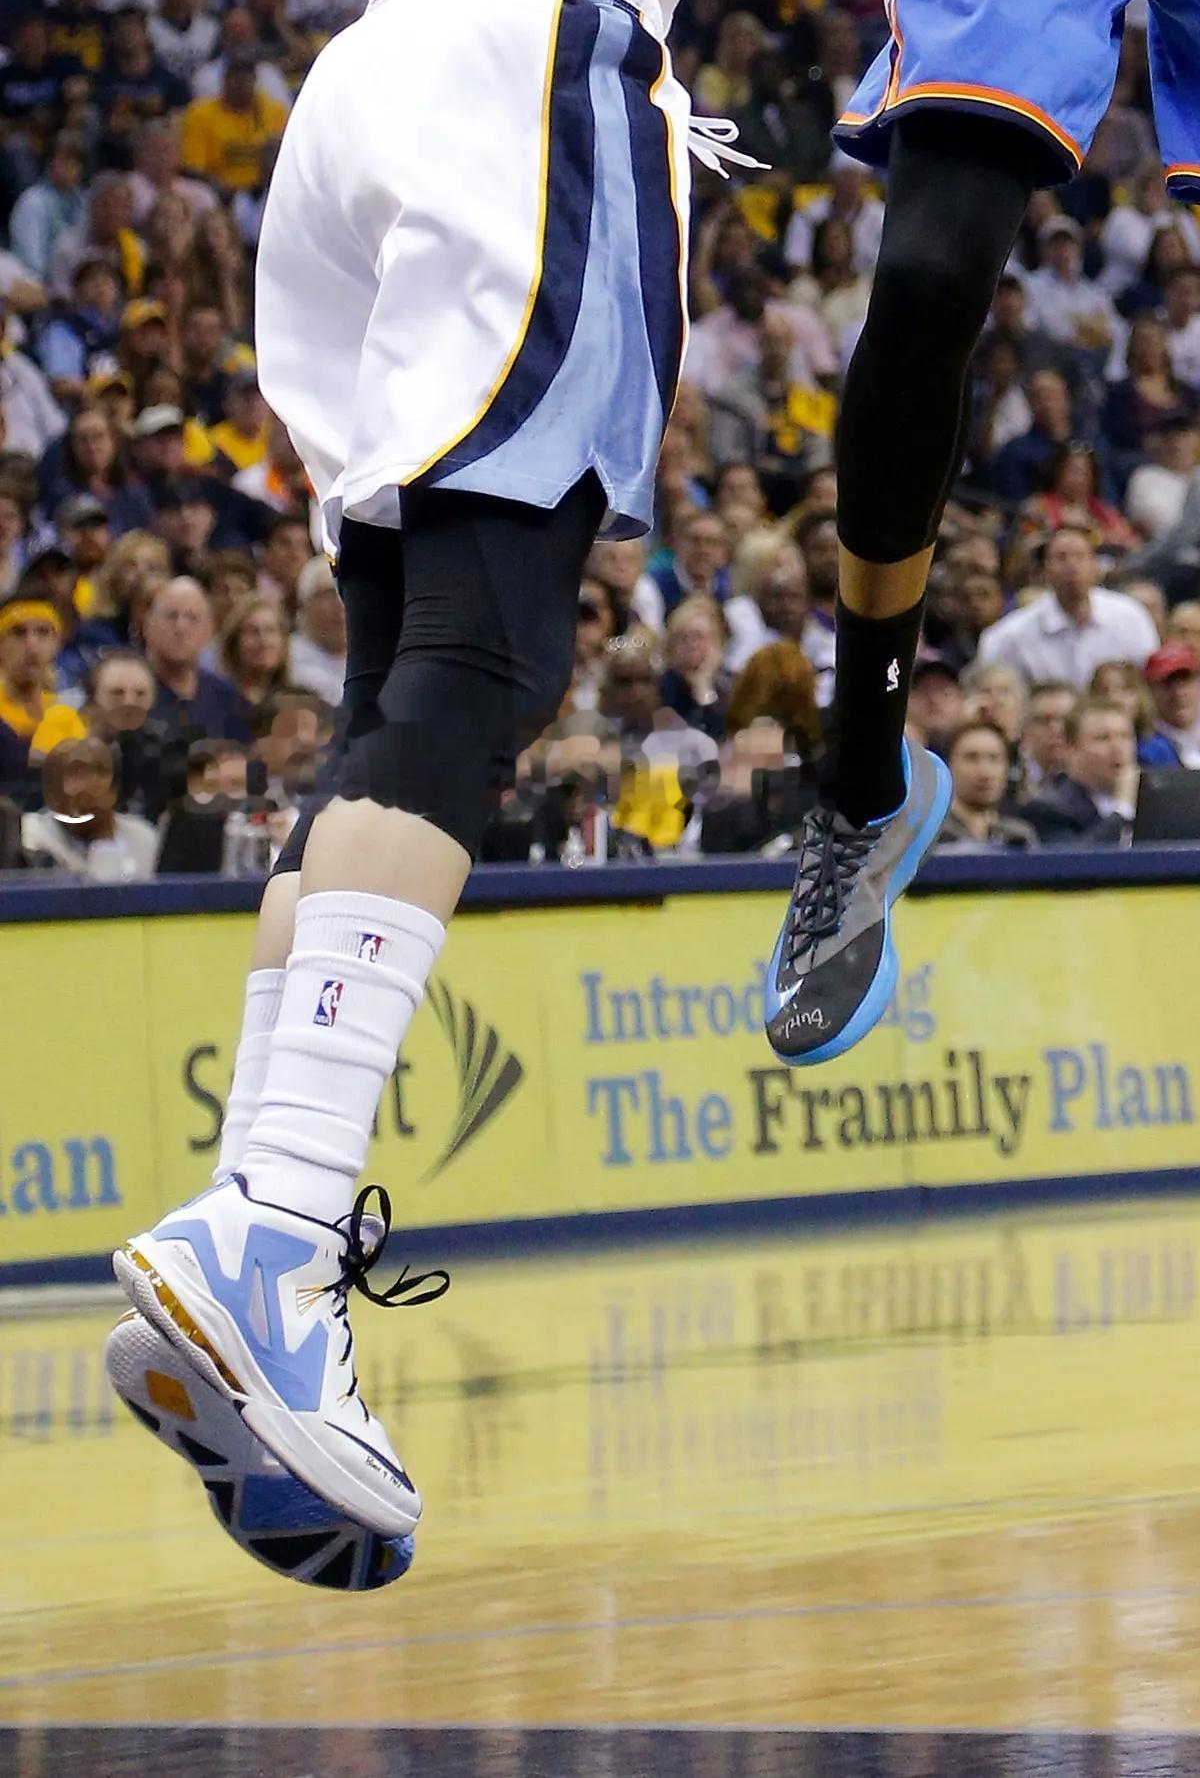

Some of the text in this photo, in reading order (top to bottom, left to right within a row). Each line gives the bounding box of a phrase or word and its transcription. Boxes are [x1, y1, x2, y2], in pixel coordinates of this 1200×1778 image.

[580, 963, 935, 1044] Introdg
[586, 1040, 1195, 1167] The Framily Plan
[0, 1133, 122, 1219] an
